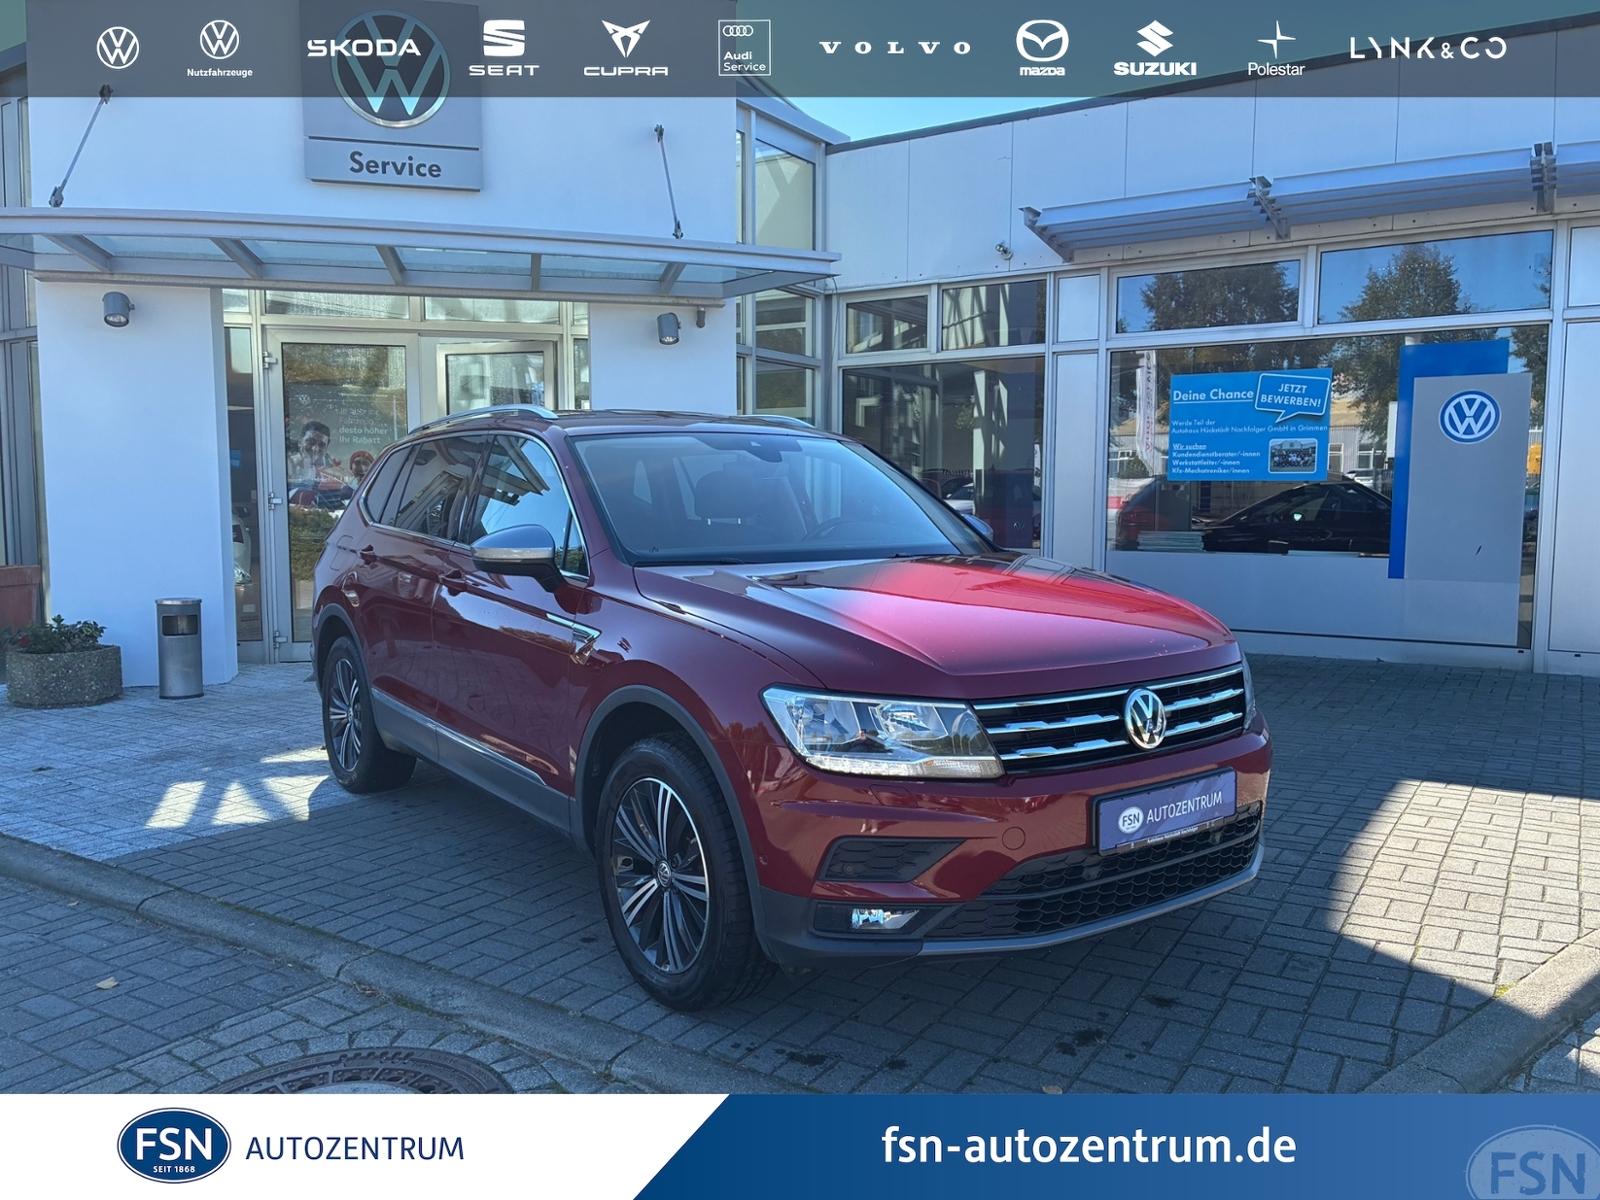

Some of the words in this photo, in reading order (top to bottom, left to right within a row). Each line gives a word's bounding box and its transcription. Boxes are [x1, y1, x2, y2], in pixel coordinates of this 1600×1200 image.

[349, 151, 443, 178] Service
[1173, 389, 1206, 401] Deine
[1209, 388, 1254, 400] Chance
[1278, 383, 1308, 394] JETZT
[1260, 394, 1321, 407] BEWERBEN!
[1231, 425, 1266, 434] Nachfolger
[1267, 424, 1289, 432] GmbH
[1122, 812, 1140, 828] FSN
[1146, 791, 1223, 824] AUTOZENTRUM
